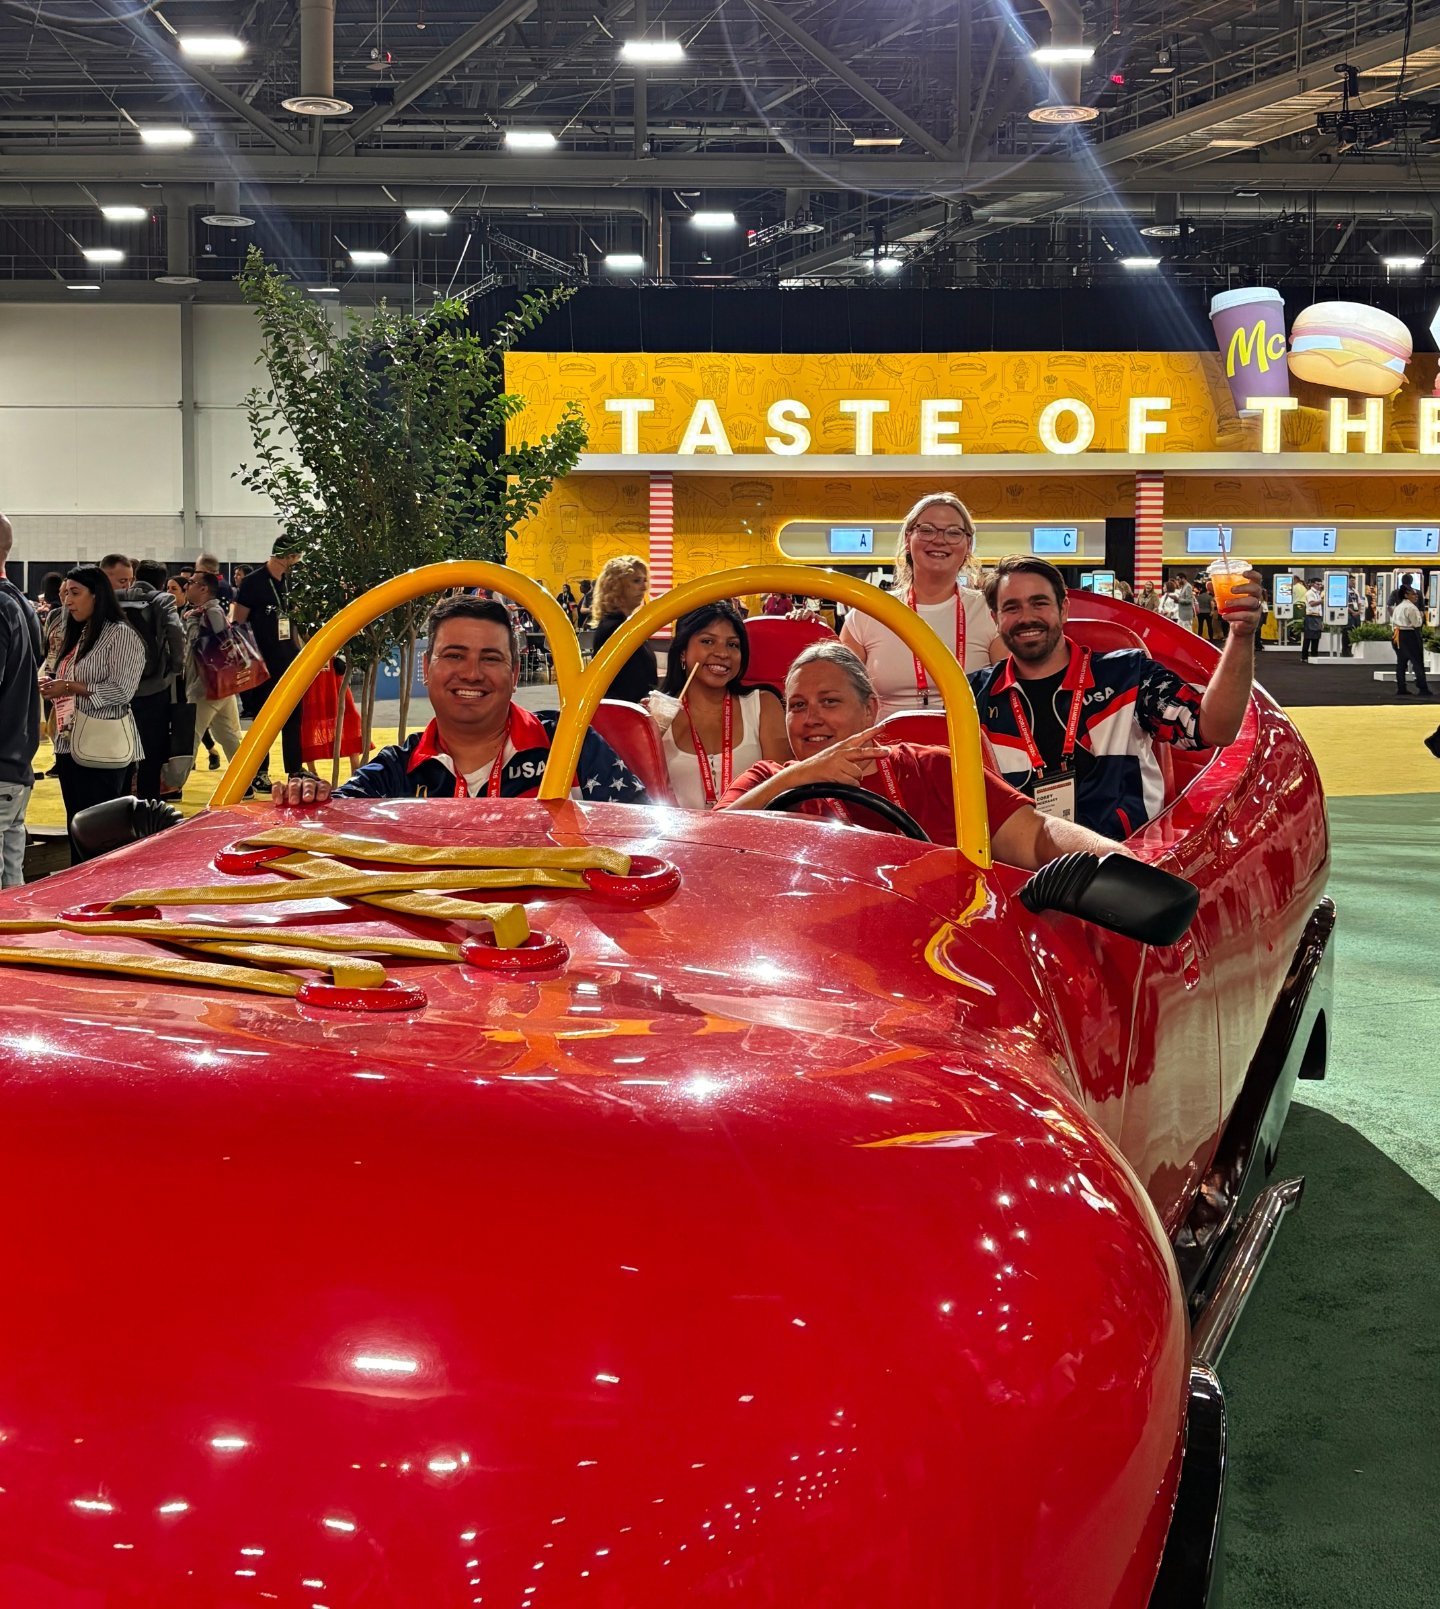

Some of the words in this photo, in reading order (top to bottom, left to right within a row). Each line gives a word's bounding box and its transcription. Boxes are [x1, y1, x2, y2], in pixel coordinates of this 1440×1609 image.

[1226, 319, 1286, 378] Mc
[605, 398, 963, 456] TASTE
[1038, 397, 1172, 455] OF
[859, 533, 867, 548] A
[1063, 533, 1071, 547] C
[1323, 533, 1329, 547] E
[1426, 533, 1433, 547] F
[1082, 686, 1115, 706] USA
[508, 760, 546, 779] USA
